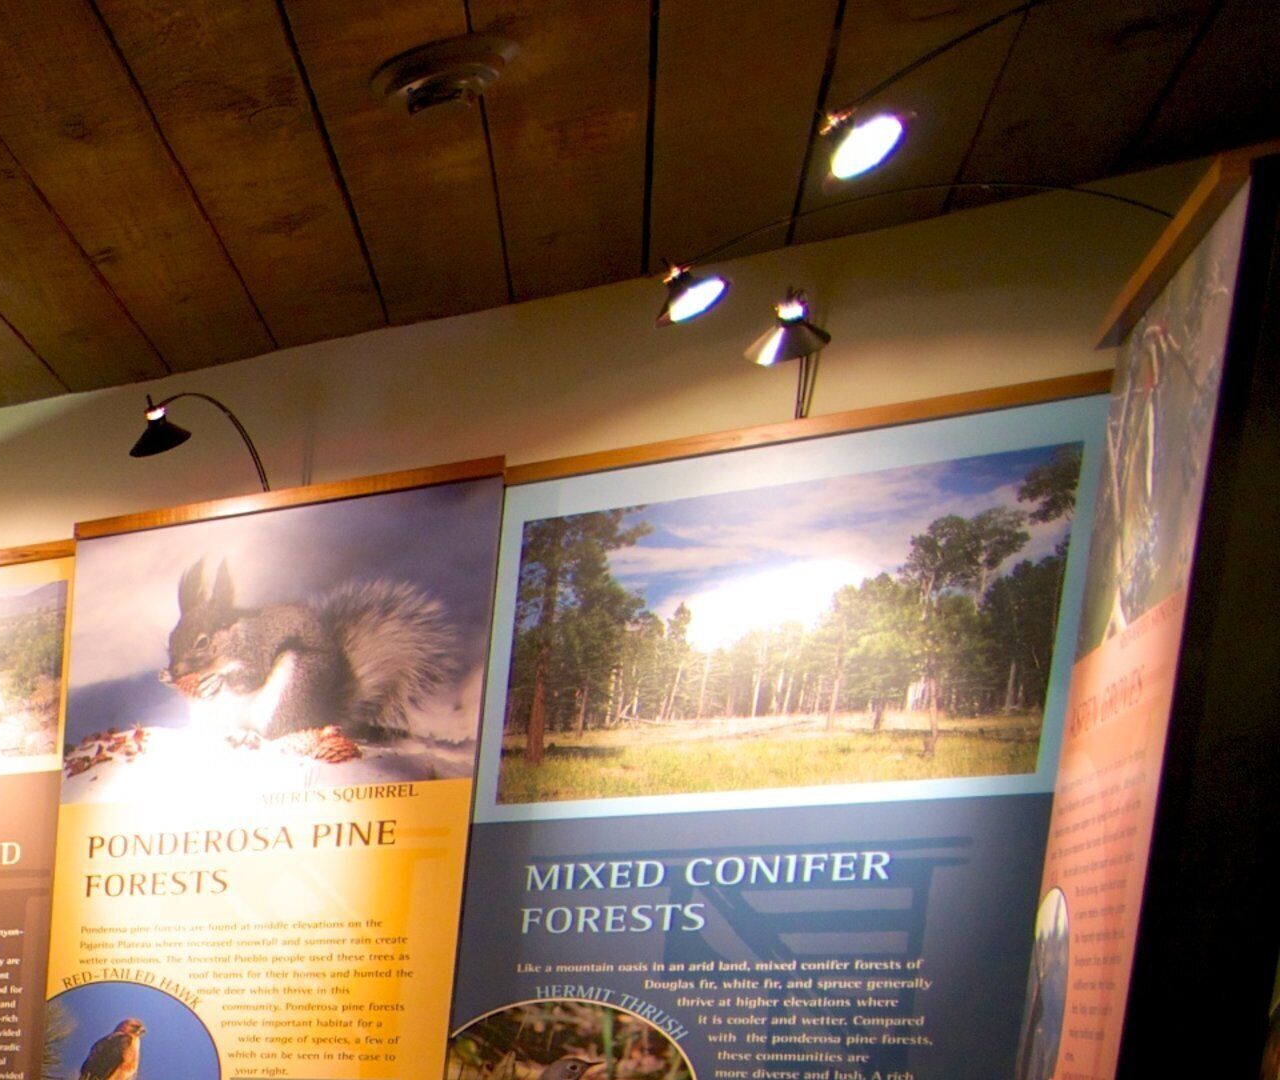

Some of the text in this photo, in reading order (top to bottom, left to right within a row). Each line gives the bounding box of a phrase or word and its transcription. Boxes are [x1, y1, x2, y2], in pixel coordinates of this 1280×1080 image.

[332, 782, 419, 802] SQUIRREL
[88, 819, 398, 859] PONDEROSA PINE
[85, 869, 229, 898] FORESTS
[524, 851, 891, 892] MIXED CONIFER
[520, 902, 705, 935] FORESTS
[517, 963, 541, 972] Like
[555, 962, 613, 972] mountain
[617, 962, 648, 971] oasis
[652, 961, 664, 971] in
[668, 963, 684, 971] an
[688, 961, 714, 971] arid
[718, 960, 750, 971] land,
[755, 959, 796, 970] mixed
[800, 959, 849, 970] conifer
[854, 959, 901, 969] forests
[906, 958, 924, 969] of
[62, 968, 200, 1009] RED-TAILED HAWK
[644, 977, 931, 991] Douglas fir, white fir, and spruce generally
[535, 983, 689, 1042] HERMIT THRUSH
[677, 996, 898, 1008] thrive at higher elevations where
[220, 1018, 257, 1027] provide
[261, 1019, 312, 1028] important
[316, 1018, 352, 1027] habitat
[357, 1018, 373, 1027] for
[227, 1050, 256, 1058] which
[337, 1051, 354, 1060] the
[357, 1053, 380, 1061] case
